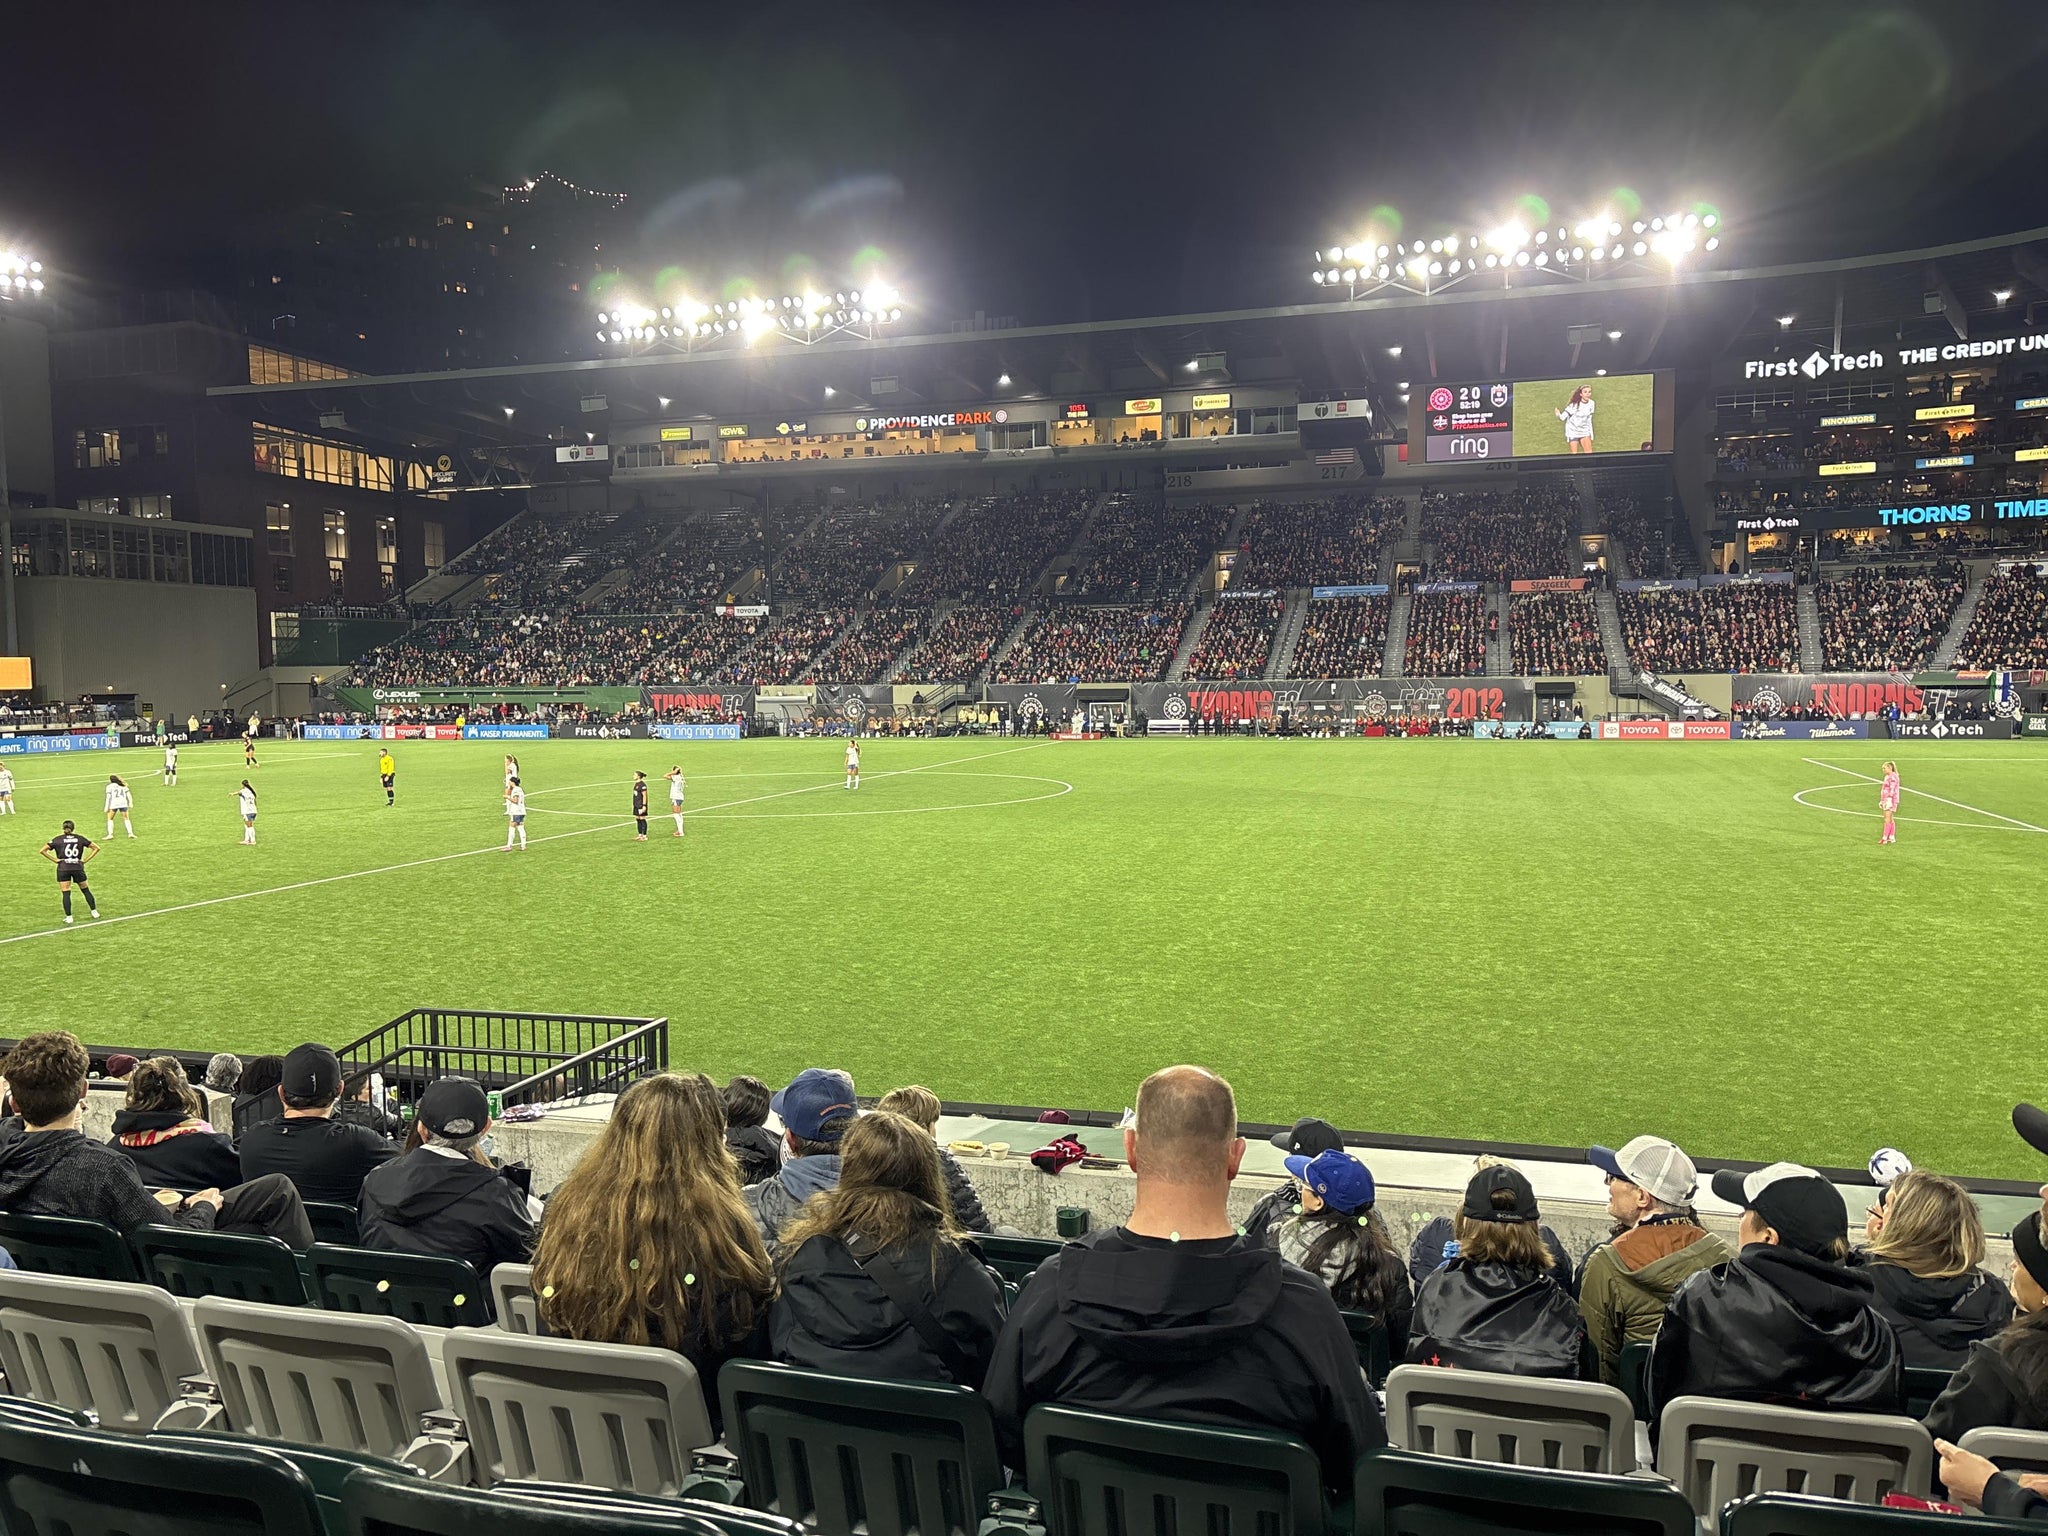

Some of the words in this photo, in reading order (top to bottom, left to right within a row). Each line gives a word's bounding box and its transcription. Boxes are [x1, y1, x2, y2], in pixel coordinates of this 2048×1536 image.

[1899, 347, 1938, 365] THE
[1941, 338, 2016, 360] CREDIT
[2020, 333, 2048, 352] UN
[1745, 360, 1799, 379] First
[1830, 350, 1884, 371] Tech
[1459, 387, 1469, 401] 2
[1471, 386, 1481, 400] 0
[1459, 400, 1481, 410] 52:19
[1822, 415, 1875, 426] INNOVATORS
[1450, 435, 1489, 458] ring
[1925, 458, 1964, 467] LEADERS
[1321, 466, 1348, 480] 217
[1167, 475, 1193, 488] 218
[1878, 505, 1971, 525] THORNS
[1737, 519, 1762, 529] First
[1775, 516, 1799, 527] Tech
[1530, 580, 1571, 590] SEATGEEK
[1446, 687, 1504, 718] 2012
[1811, 683, 1923, 719] THORNS
[2029, 717, 2047, 725] SEAT
[306, 726, 322, 739] ring
[324, 726, 340, 739] ring
[480, 730, 501, 738] KAISER
[575, 726, 597, 736] First
[674, 725, 693, 738] ring
[695, 725, 714, 738] ring
[717, 725, 736, 738] ring
[1622, 726, 1660, 734] TOYOTA
[1687, 726, 1726, 734] TOYOTA
[1809, 727, 1856, 738] Tillamook
[1949, 724, 1984, 735] Tech
[28, 738, 48, 752] ring
[51, 737, 71, 751] ring
[78, 735, 98, 749] ring
[134, 733, 156, 744] First
[168, 732, 188, 742] Tech
[114, 789, 124, 798] 24
[64, 843, 79, 858] 66
